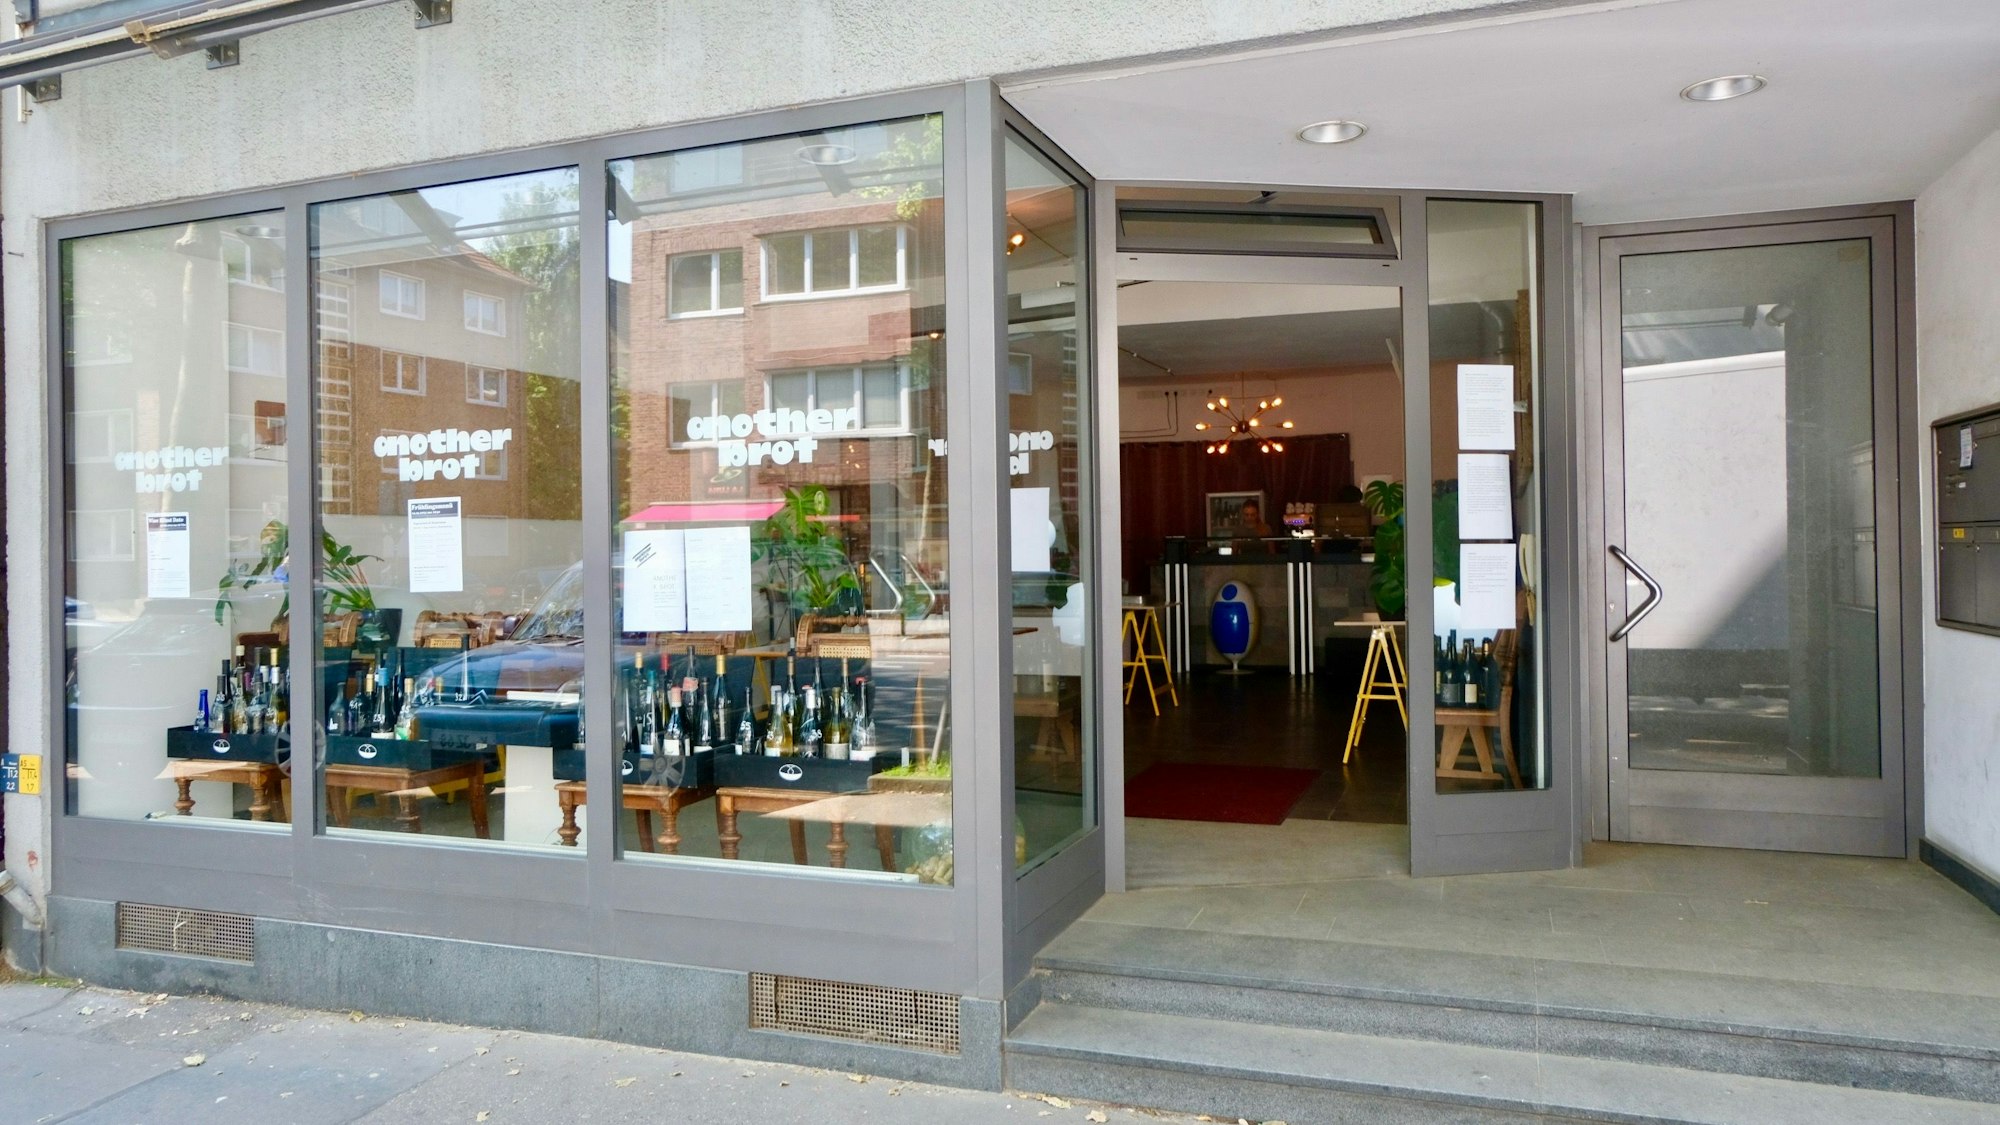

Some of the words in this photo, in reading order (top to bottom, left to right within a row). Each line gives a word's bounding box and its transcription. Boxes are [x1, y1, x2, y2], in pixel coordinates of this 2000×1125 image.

[686, 407, 858, 440] another
[373, 428, 512, 458] another
[717, 436, 818, 467] brot
[114, 445, 230, 471] another
[399, 454, 480, 482] brot
[135, 469, 203, 493] brot
